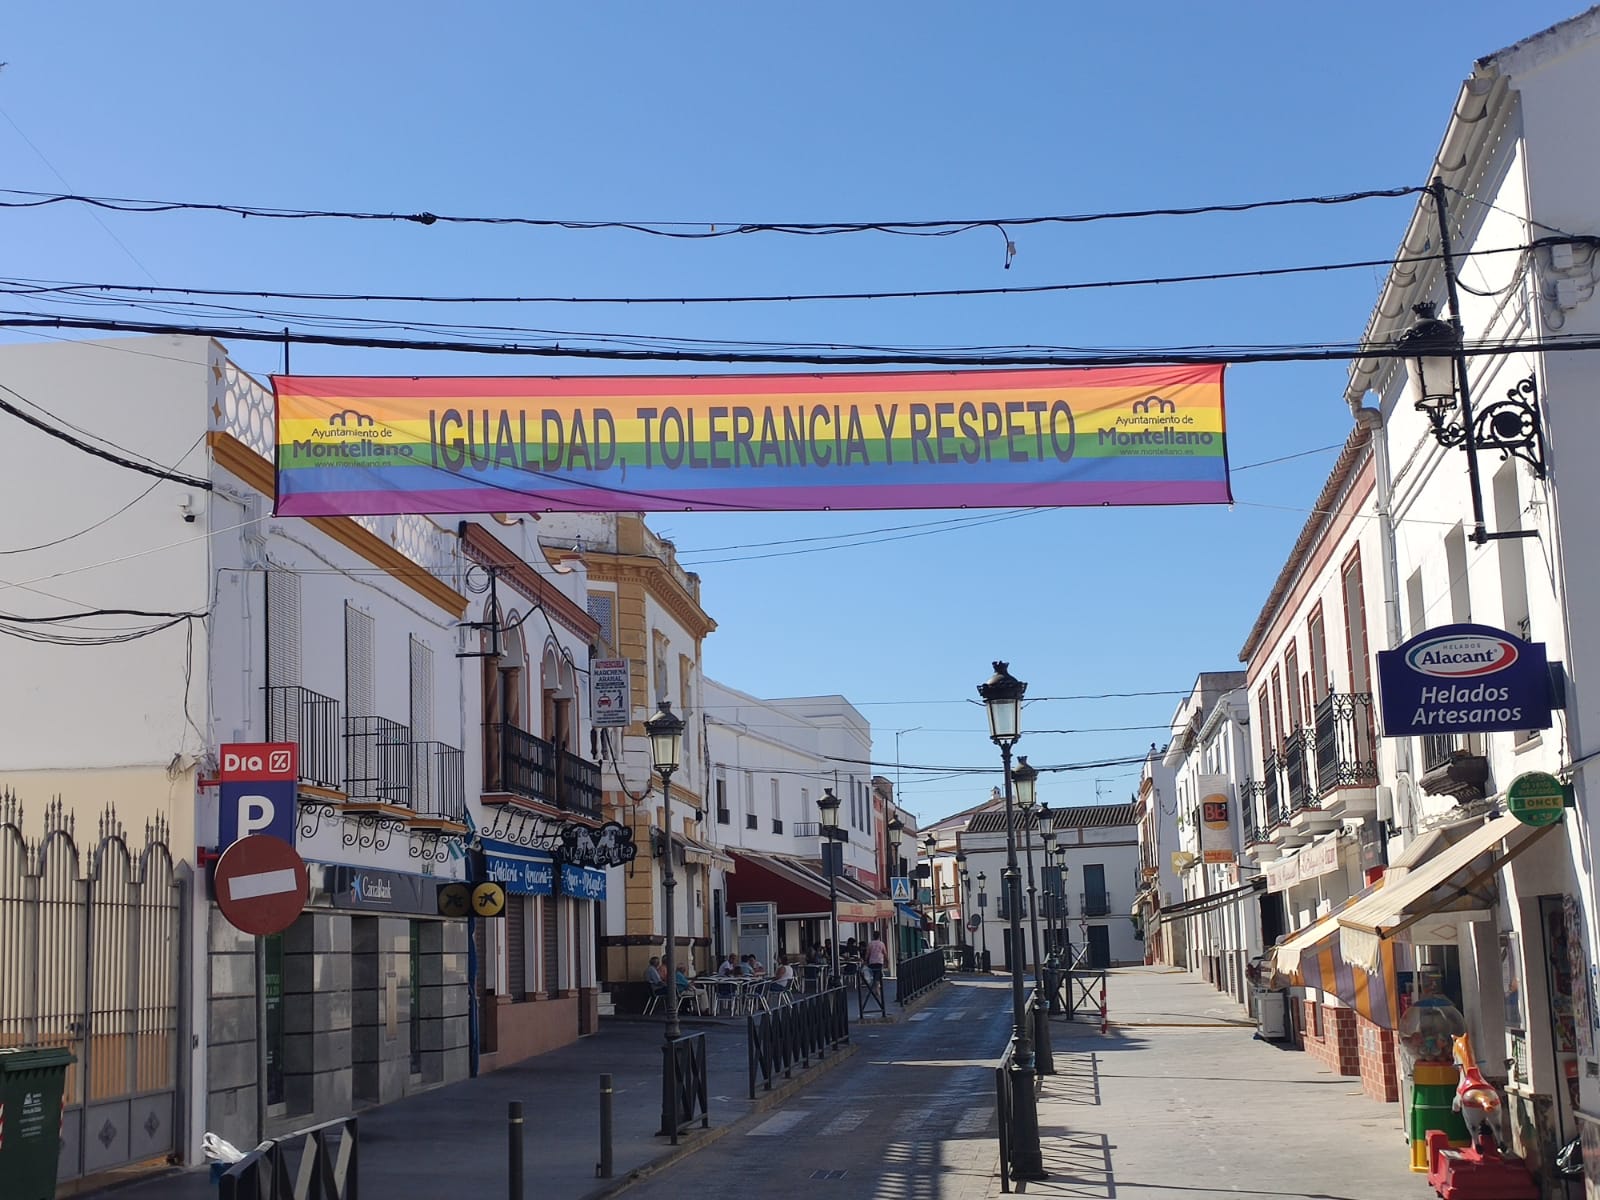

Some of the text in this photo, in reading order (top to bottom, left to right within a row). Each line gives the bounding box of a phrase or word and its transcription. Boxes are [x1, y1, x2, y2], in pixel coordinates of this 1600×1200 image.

[1115, 415, 1194, 427] Ayuntamiento de
[311, 428, 393, 439] Ayuntamiento de
[428, 399, 1077, 484] IGUALDAD, TOLERANCIA Y RESPETO
[1097, 426, 1214, 446] Montellano
[292, 438, 414, 459] Montellano
[1119, 448, 1194, 457] www.montellano.es
[1442, 642, 1482, 650] HELADOS
[1421, 650, 1495, 666] Alacant
[1420, 684, 1509, 705] Helados
[1411, 706, 1522, 726] Artesanos
[237, 795, 275, 840] P
